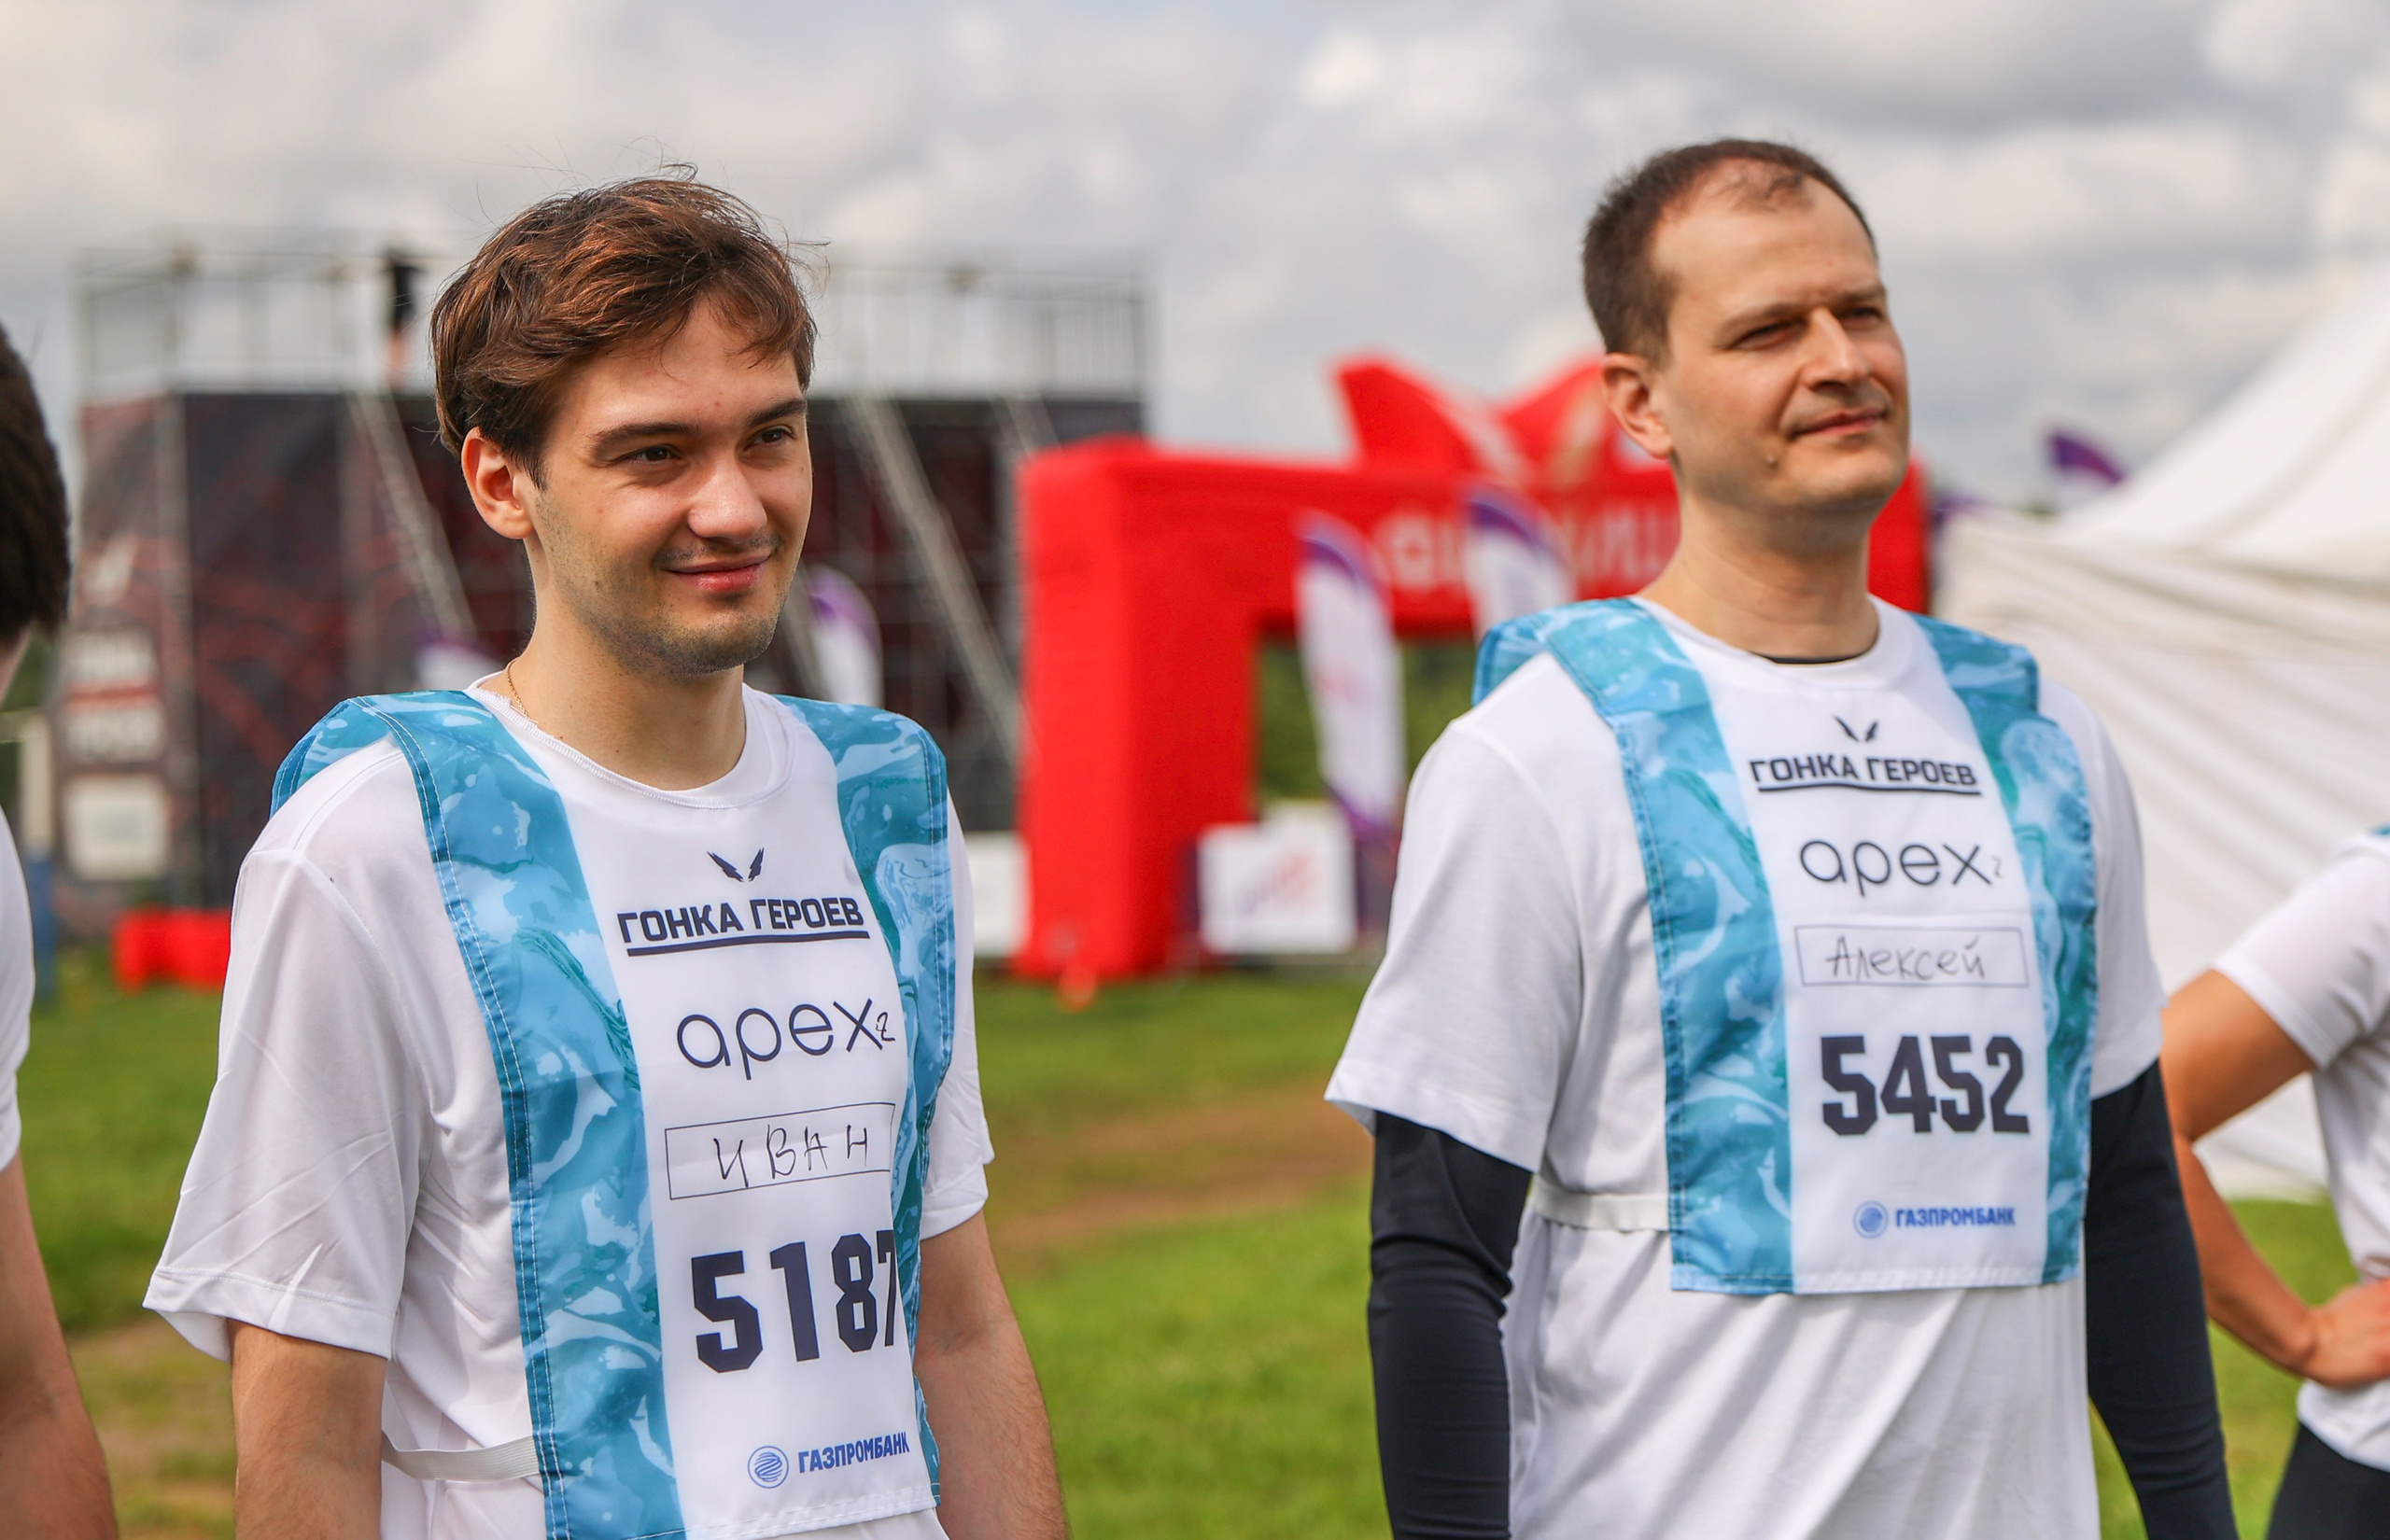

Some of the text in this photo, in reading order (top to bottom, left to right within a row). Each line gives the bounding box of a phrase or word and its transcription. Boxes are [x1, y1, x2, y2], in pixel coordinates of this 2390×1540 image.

[1750, 754, 1977, 786] ГОНКА ГЕРОЕВ
[617, 896, 865, 944] ГОНКА ГЕРОЕВ
[1821, 1035, 2030, 1136] 5452
[712, 1124, 868, 1188] ИВАН
[1895, 1207, 2017, 1229] ГАЗПРОМБАНК
[691, 1229, 898, 1373] 5187
[798, 1431, 910, 1475] ГАЗПРОМБАНК
